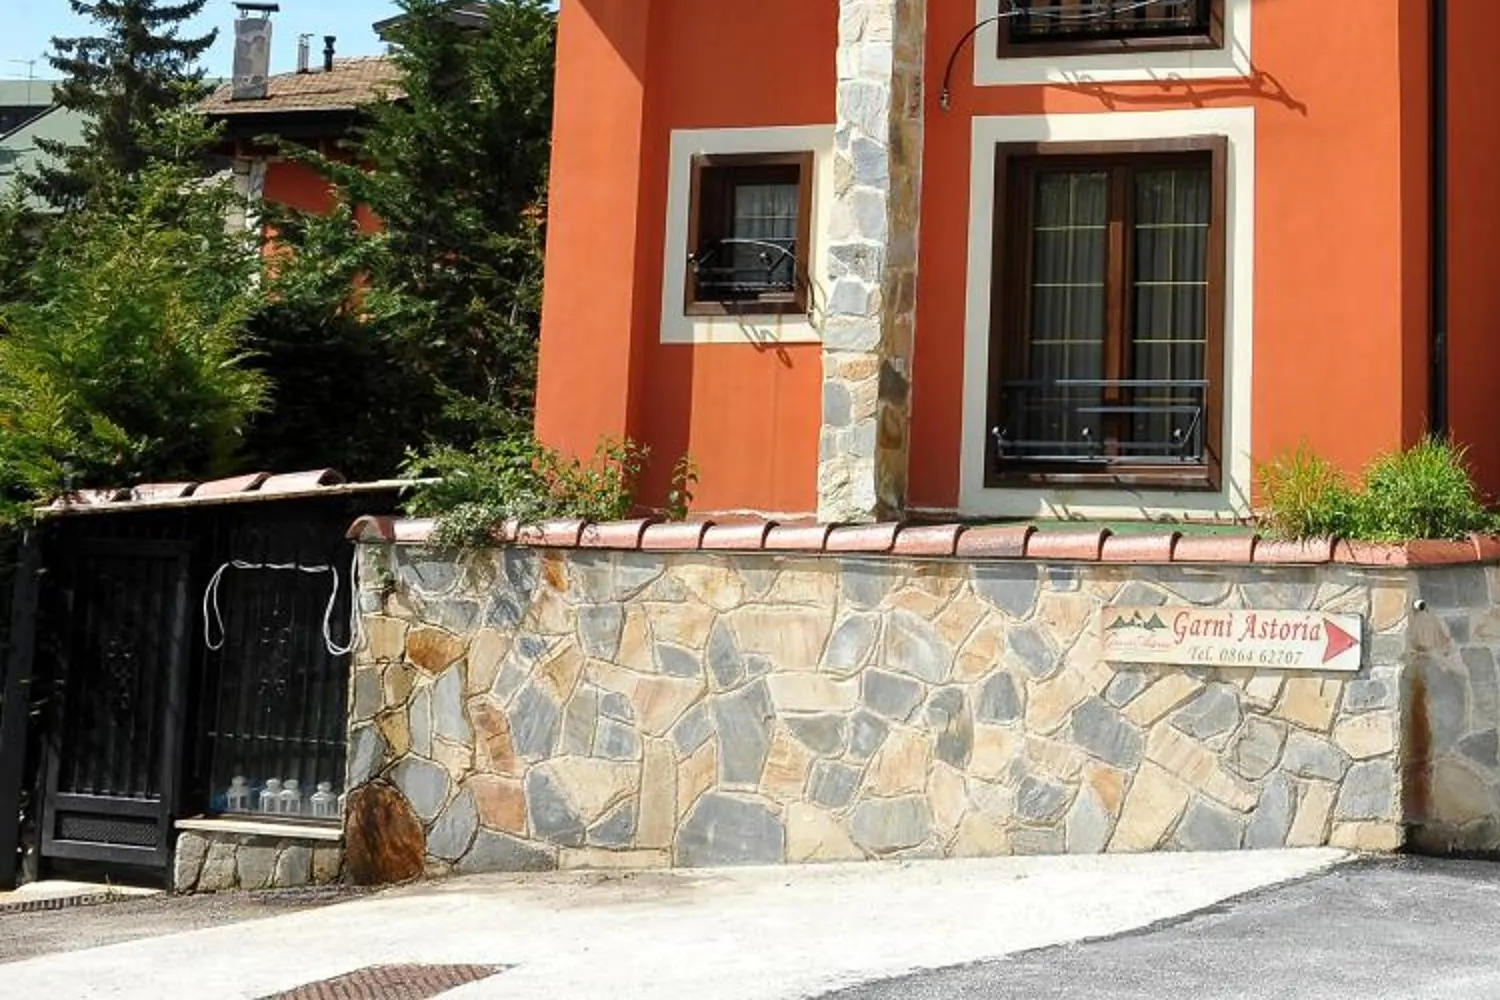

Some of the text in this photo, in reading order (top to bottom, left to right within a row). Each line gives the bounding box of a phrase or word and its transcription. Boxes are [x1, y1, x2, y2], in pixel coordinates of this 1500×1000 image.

[1237, 612, 1321, 642] Astoria
[1190, 646, 1213, 662] Tel.
[1220, 648, 1253, 662] 0864
